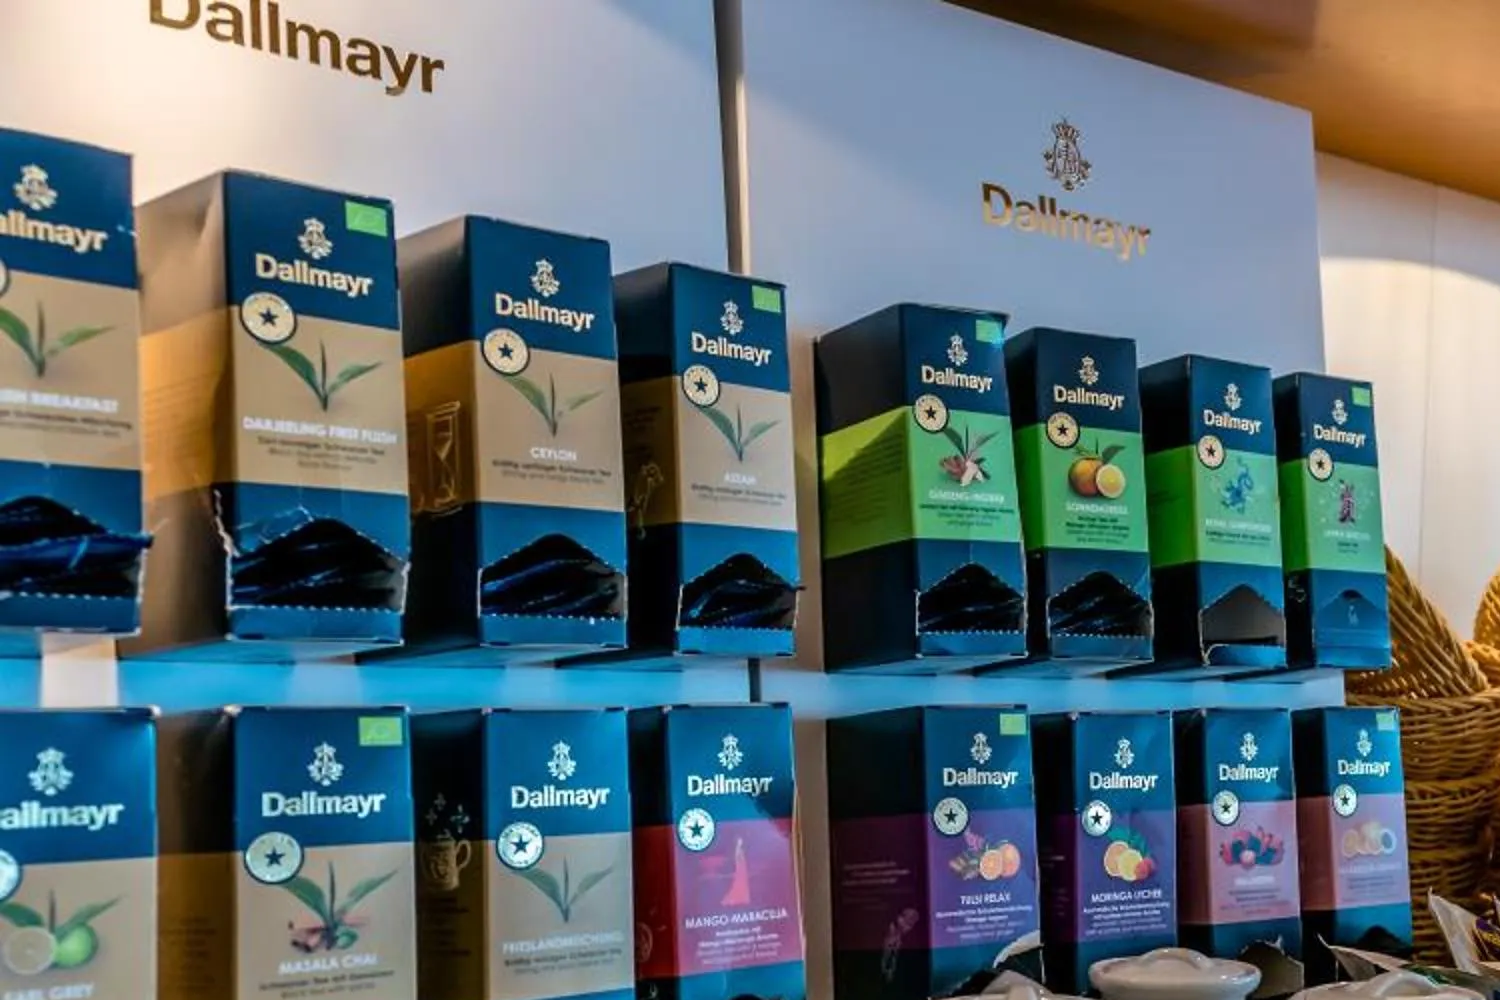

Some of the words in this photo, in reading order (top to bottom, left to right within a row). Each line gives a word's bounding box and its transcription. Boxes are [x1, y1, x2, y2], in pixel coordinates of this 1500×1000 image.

[0, 209, 108, 254] llmayr
[981, 182, 1151, 261] Dallmayr
[255, 253, 373, 298] Dallmayr
[495, 293, 595, 333] Dallmayr
[691, 331, 772, 366] Dallmayr
[921, 365, 993, 393] Dallmayr
[1053, 385, 1125, 410] Dallmayr
[1203, 409, 1262, 435] Dallmayr
[1313, 424, 1366, 447] Dallmayr
[943, 768, 1019, 788] Dallmayr
[1089, 771, 1158, 791] Dallmayr
[1219, 763, 1279, 782] Dallmayr
[1337, 760, 1391, 777] Dallmayr
[511, 784, 611, 810] Dallmayr
[687, 774, 774, 797] Dallmayr
[0, 800, 125, 831] allmayr
[261, 790, 387, 819] Dallmayr
